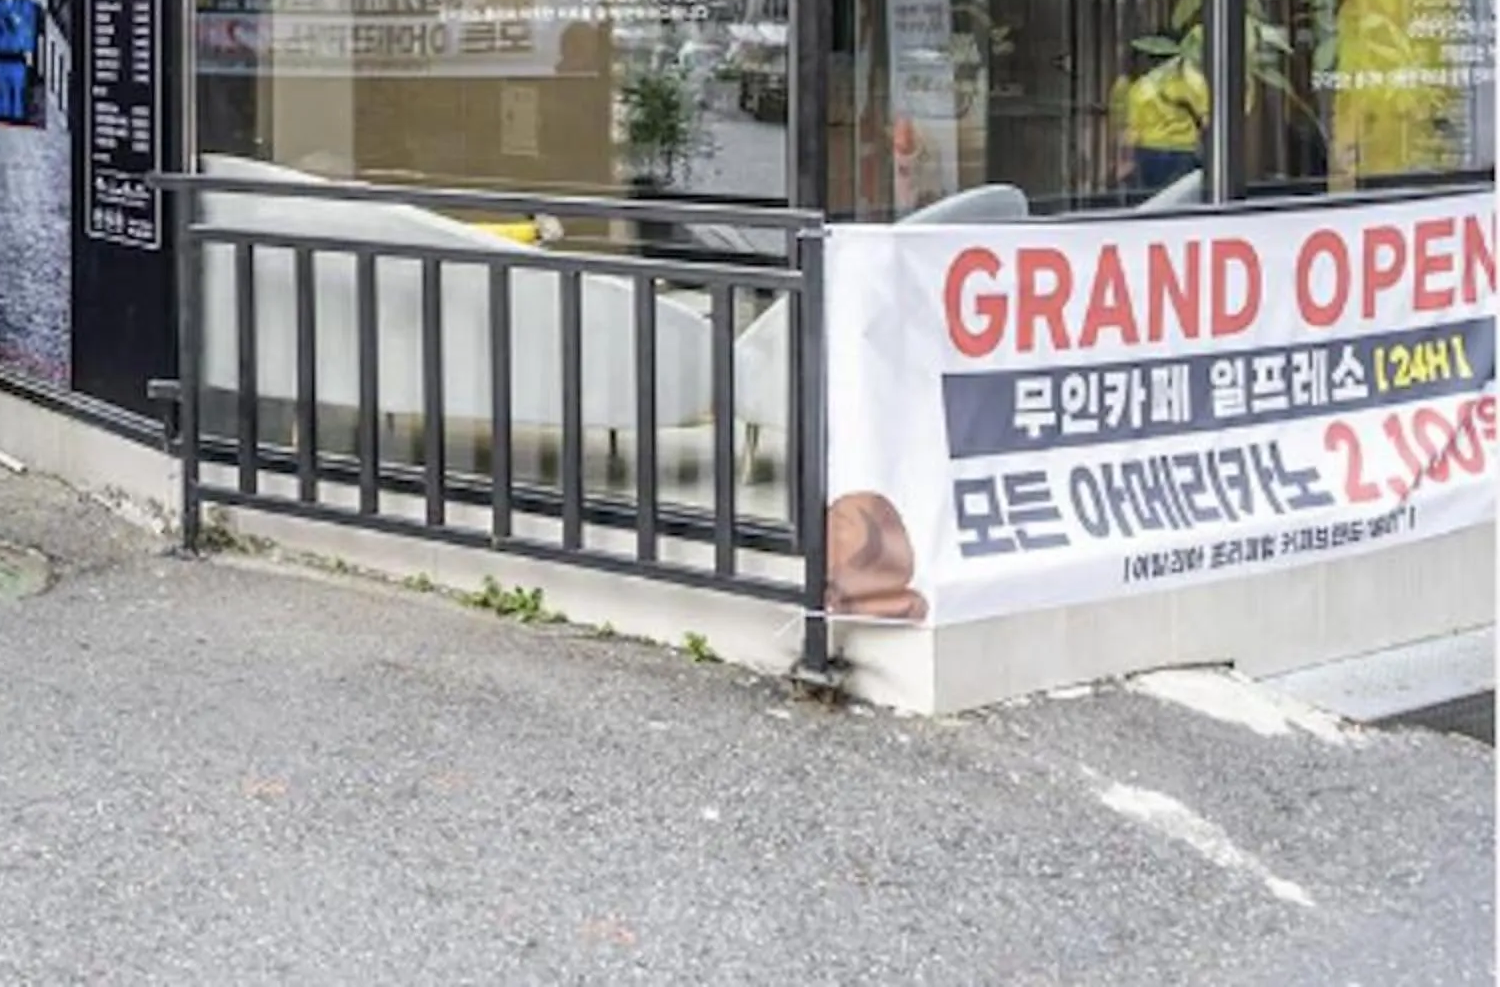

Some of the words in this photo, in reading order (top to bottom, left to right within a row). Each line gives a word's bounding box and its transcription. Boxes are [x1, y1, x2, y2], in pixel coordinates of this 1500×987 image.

[942, 237, 1263, 358] GRAND
[1295, 215, 1495, 327] OPEN
[1011, 365, 1192, 439] 무인카페
[1208, 344, 1370, 420] 일프레소
[953, 468, 1071, 558] 모든
[1068, 440, 1336, 542] 아메리카노
